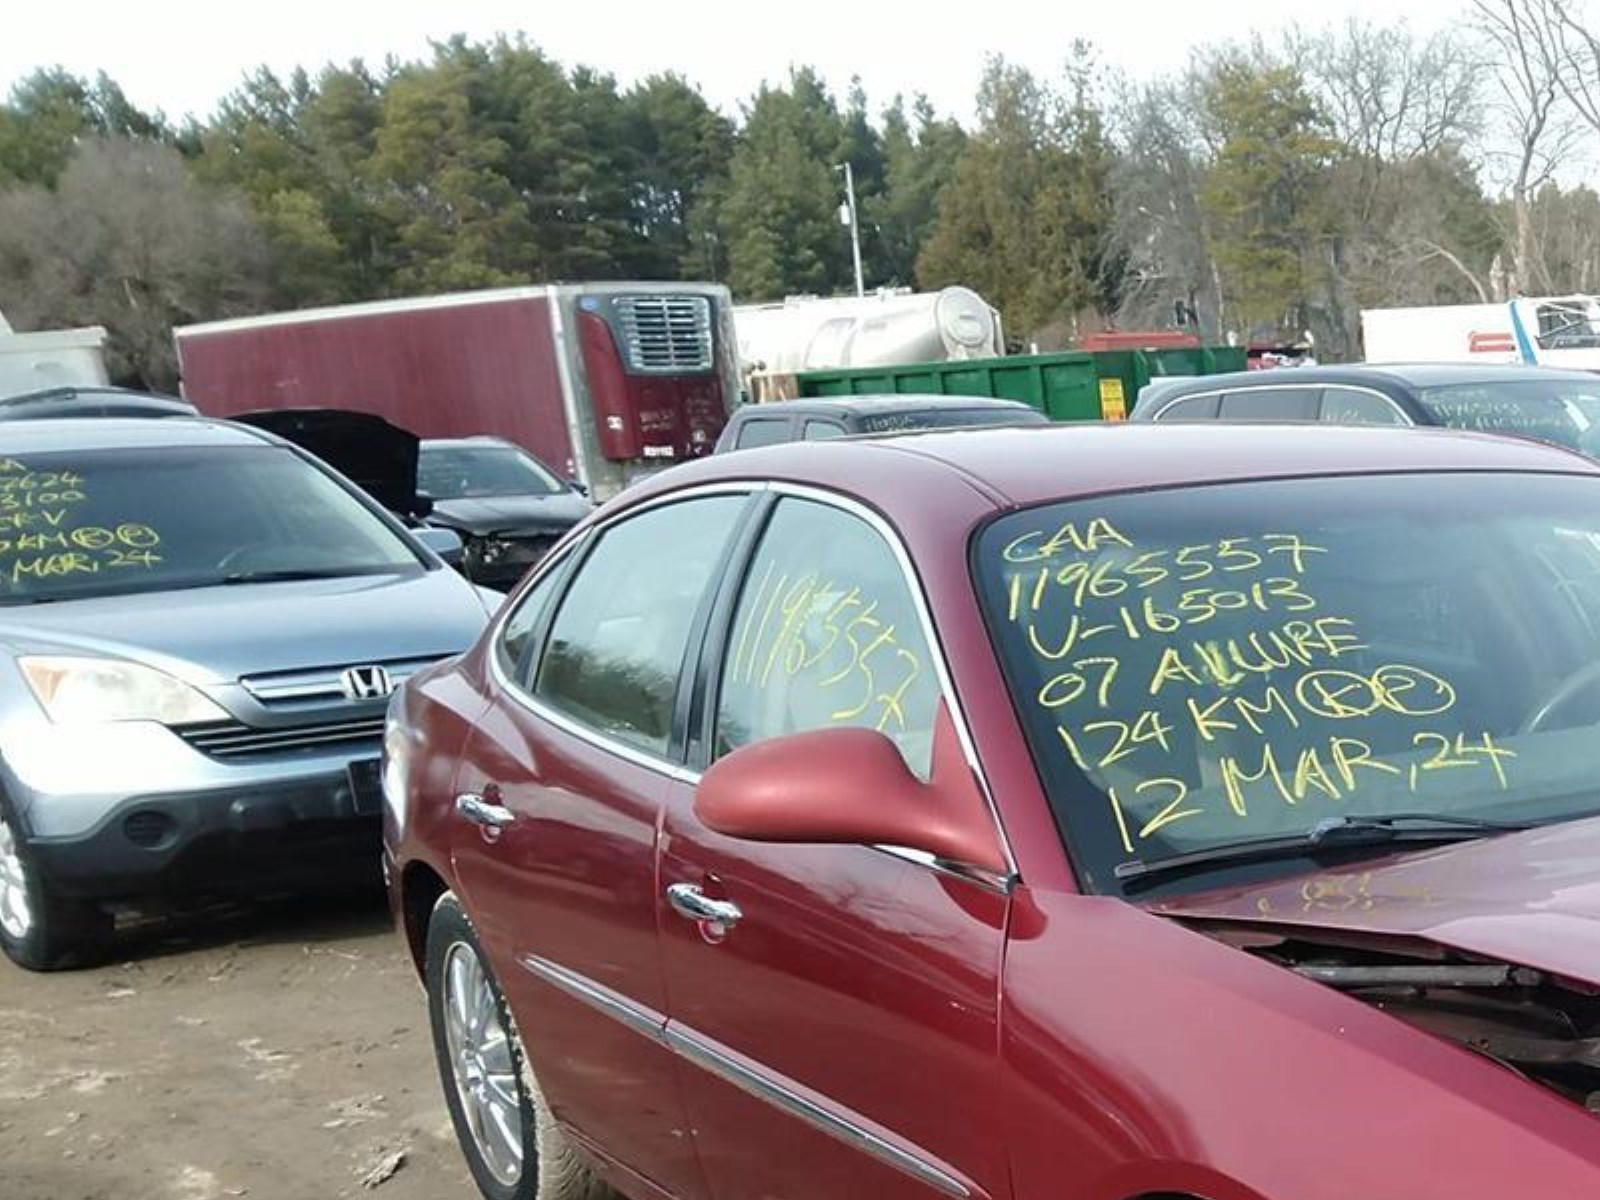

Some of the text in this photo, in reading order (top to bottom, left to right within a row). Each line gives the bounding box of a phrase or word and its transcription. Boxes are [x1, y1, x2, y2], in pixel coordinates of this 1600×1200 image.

[1003, 517, 1133, 562] CAA
[1008, 534, 1328, 621] 11965557
[1039, 657, 1119, 707] 07
[1058, 711, 1174, 770] 124
[1109, 779, 1205, 853] 12
